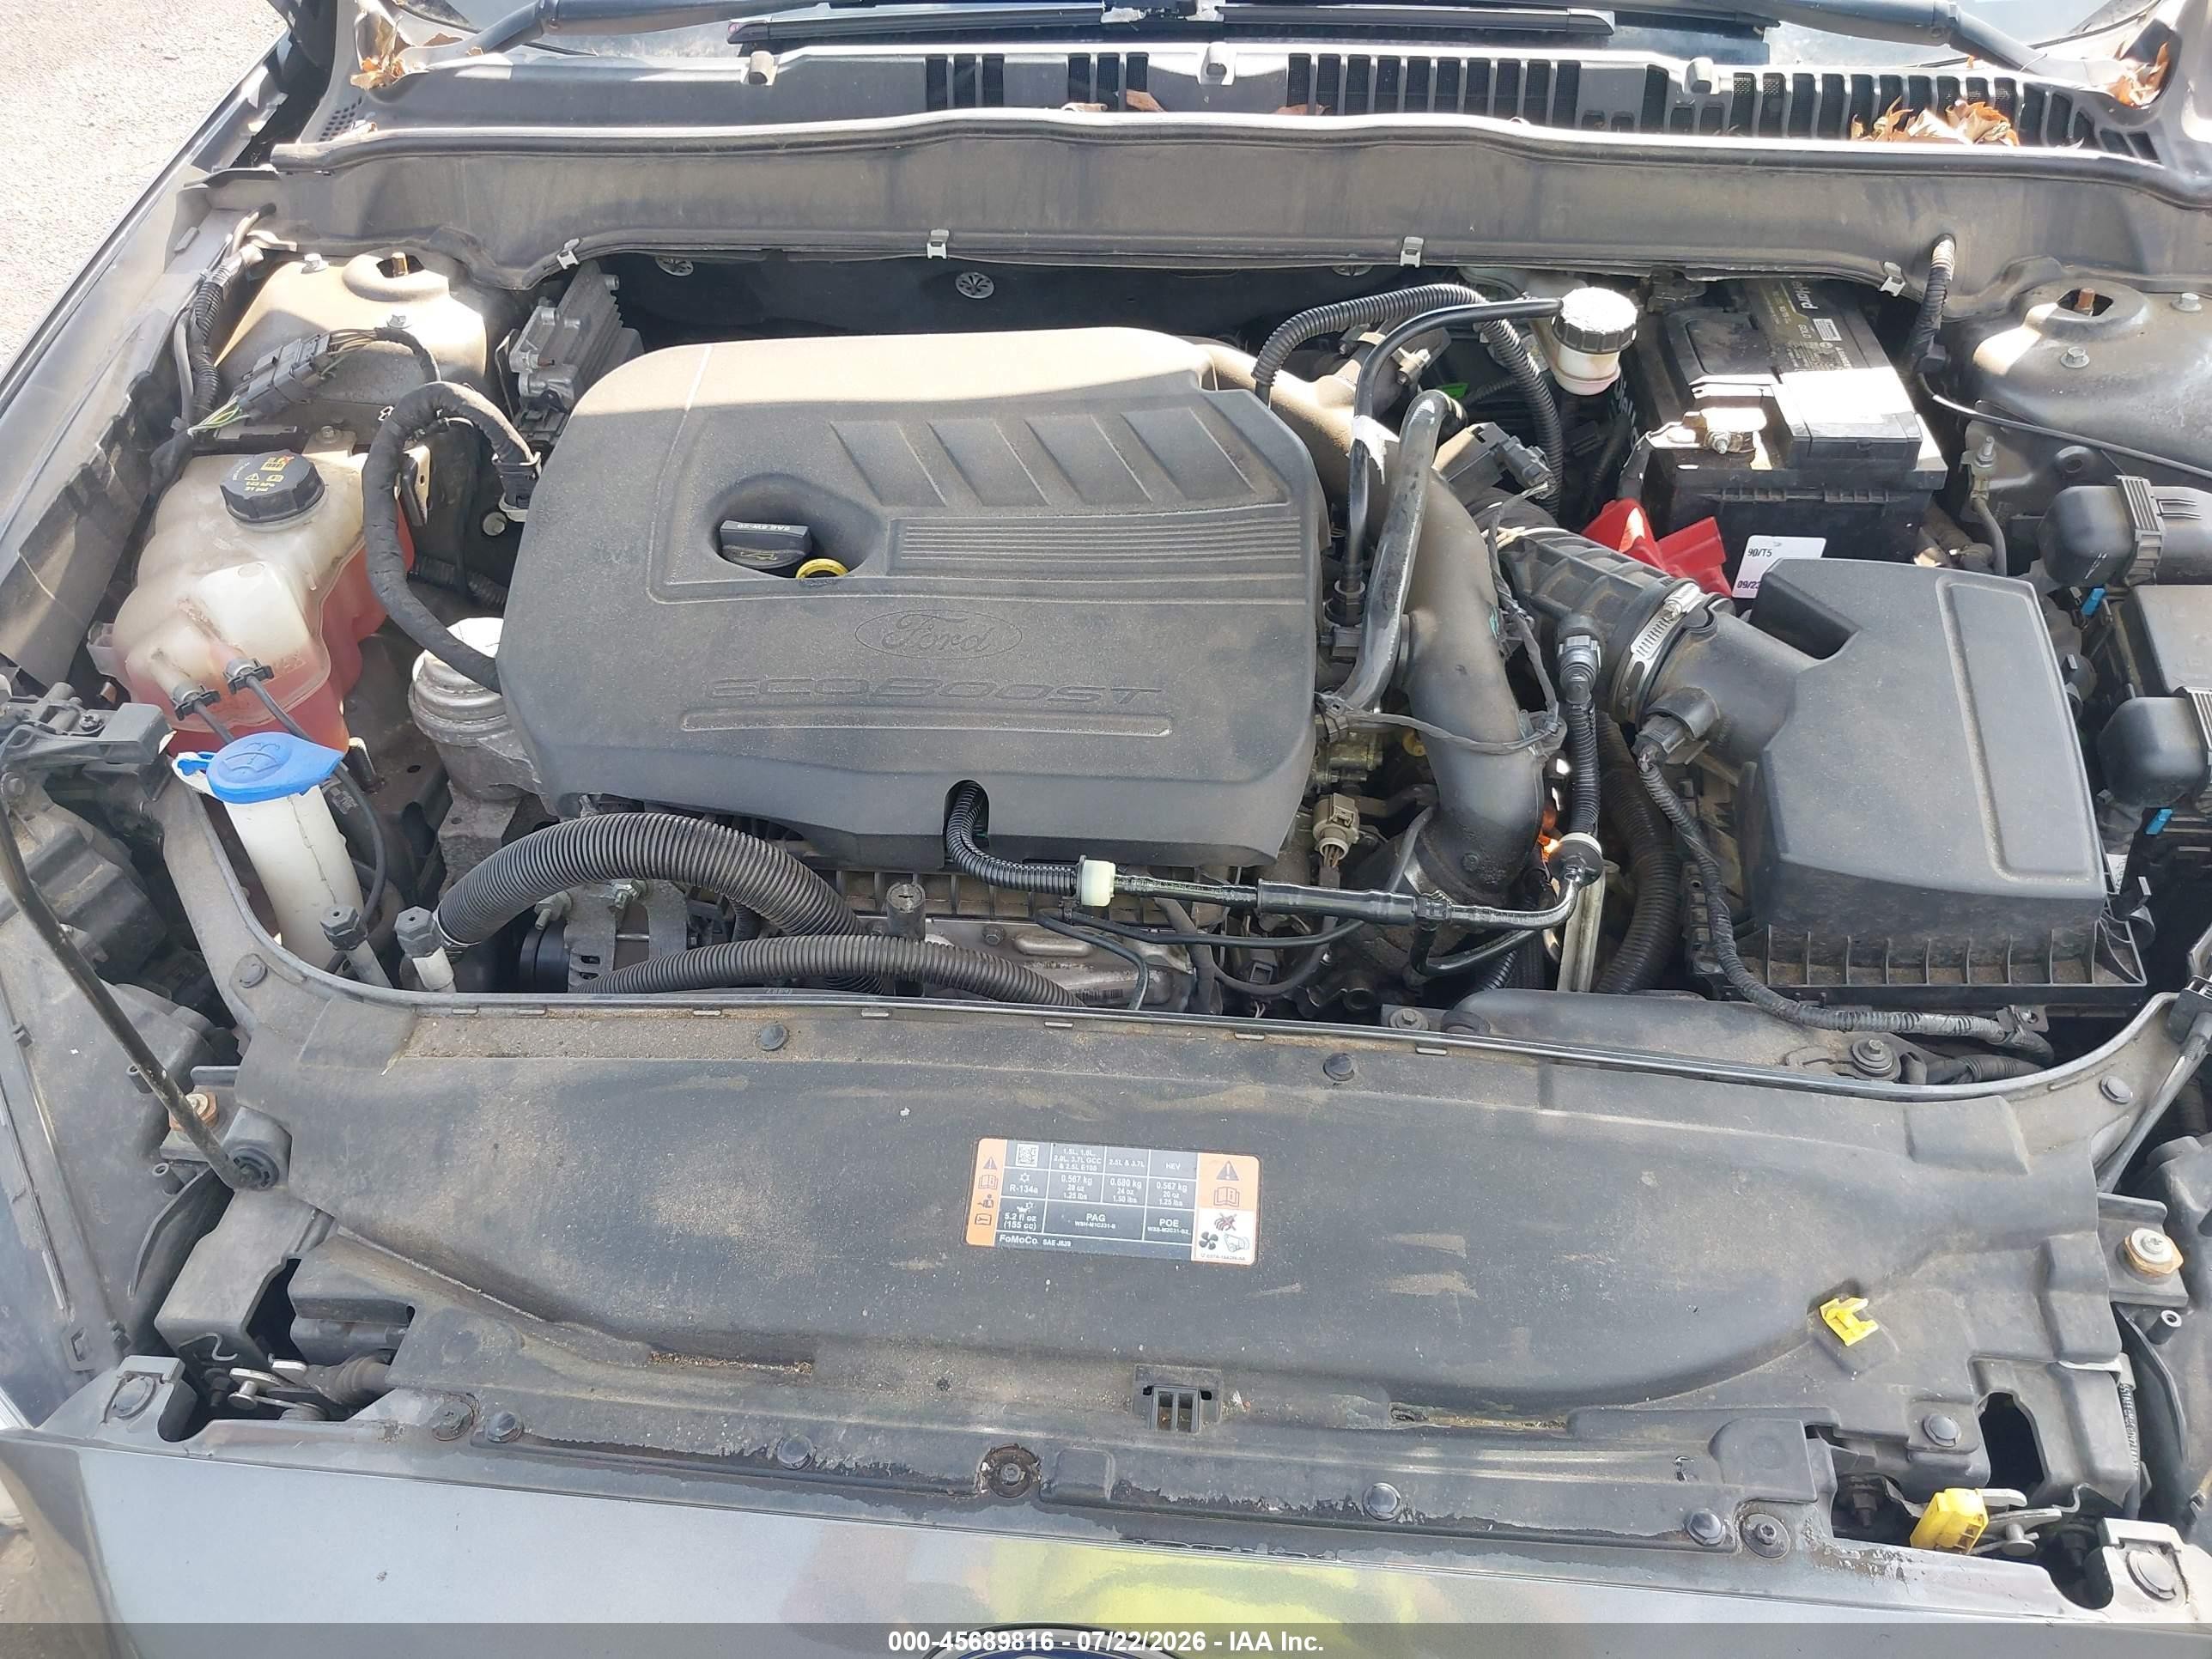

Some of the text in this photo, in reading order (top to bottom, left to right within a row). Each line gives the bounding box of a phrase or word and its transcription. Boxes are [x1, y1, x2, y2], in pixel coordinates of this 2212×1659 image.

[1747, 548, 1772, 557] 90/T5
[882, 613, 995, 651] Ford
[1083, 1176, 1093, 1186] kg
[1132, 1179, 1142, 1189] kg
[1009, 1184, 1038, 1194] R-134a
[1177, 1182, 1188, 1193] kg
[1085, 1212, 1107, 1223] PAG
[1003, 1221, 1037, 1231] (155 cc)
[1158, 1218, 1180, 1228] POE
[999, 1234, 1038, 1245] FoMoCo
